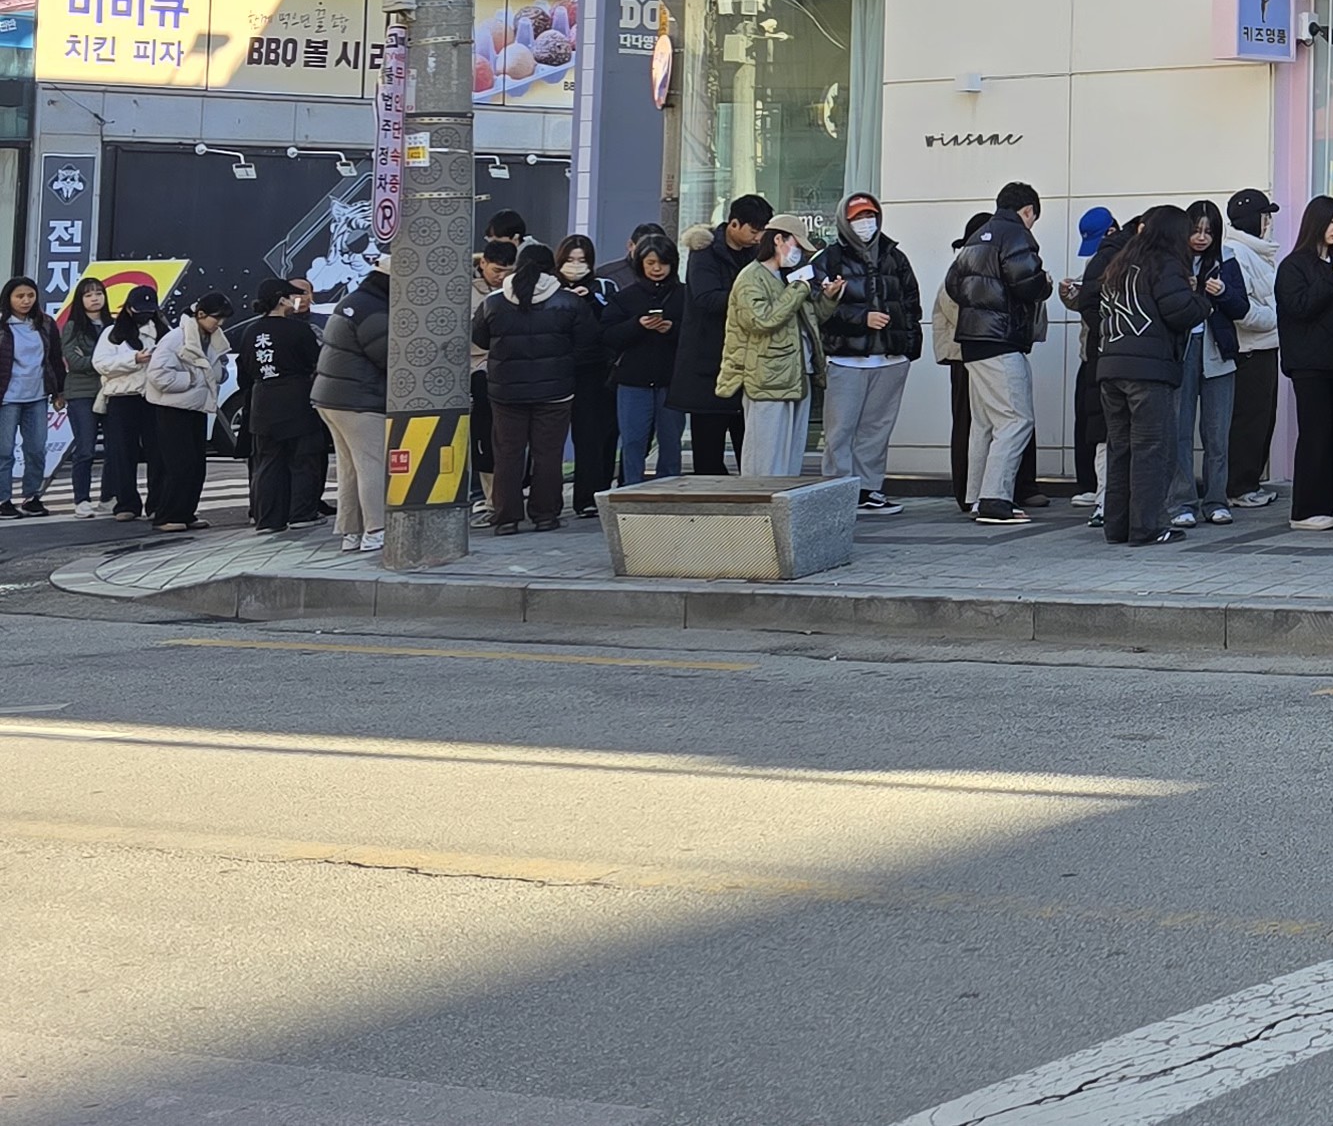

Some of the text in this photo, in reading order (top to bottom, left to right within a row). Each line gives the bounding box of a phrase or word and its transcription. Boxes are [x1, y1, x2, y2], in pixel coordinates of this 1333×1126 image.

[1243, 26, 1287, 45] 키즈명품
[64, 33, 185, 67] 치킨 피자
